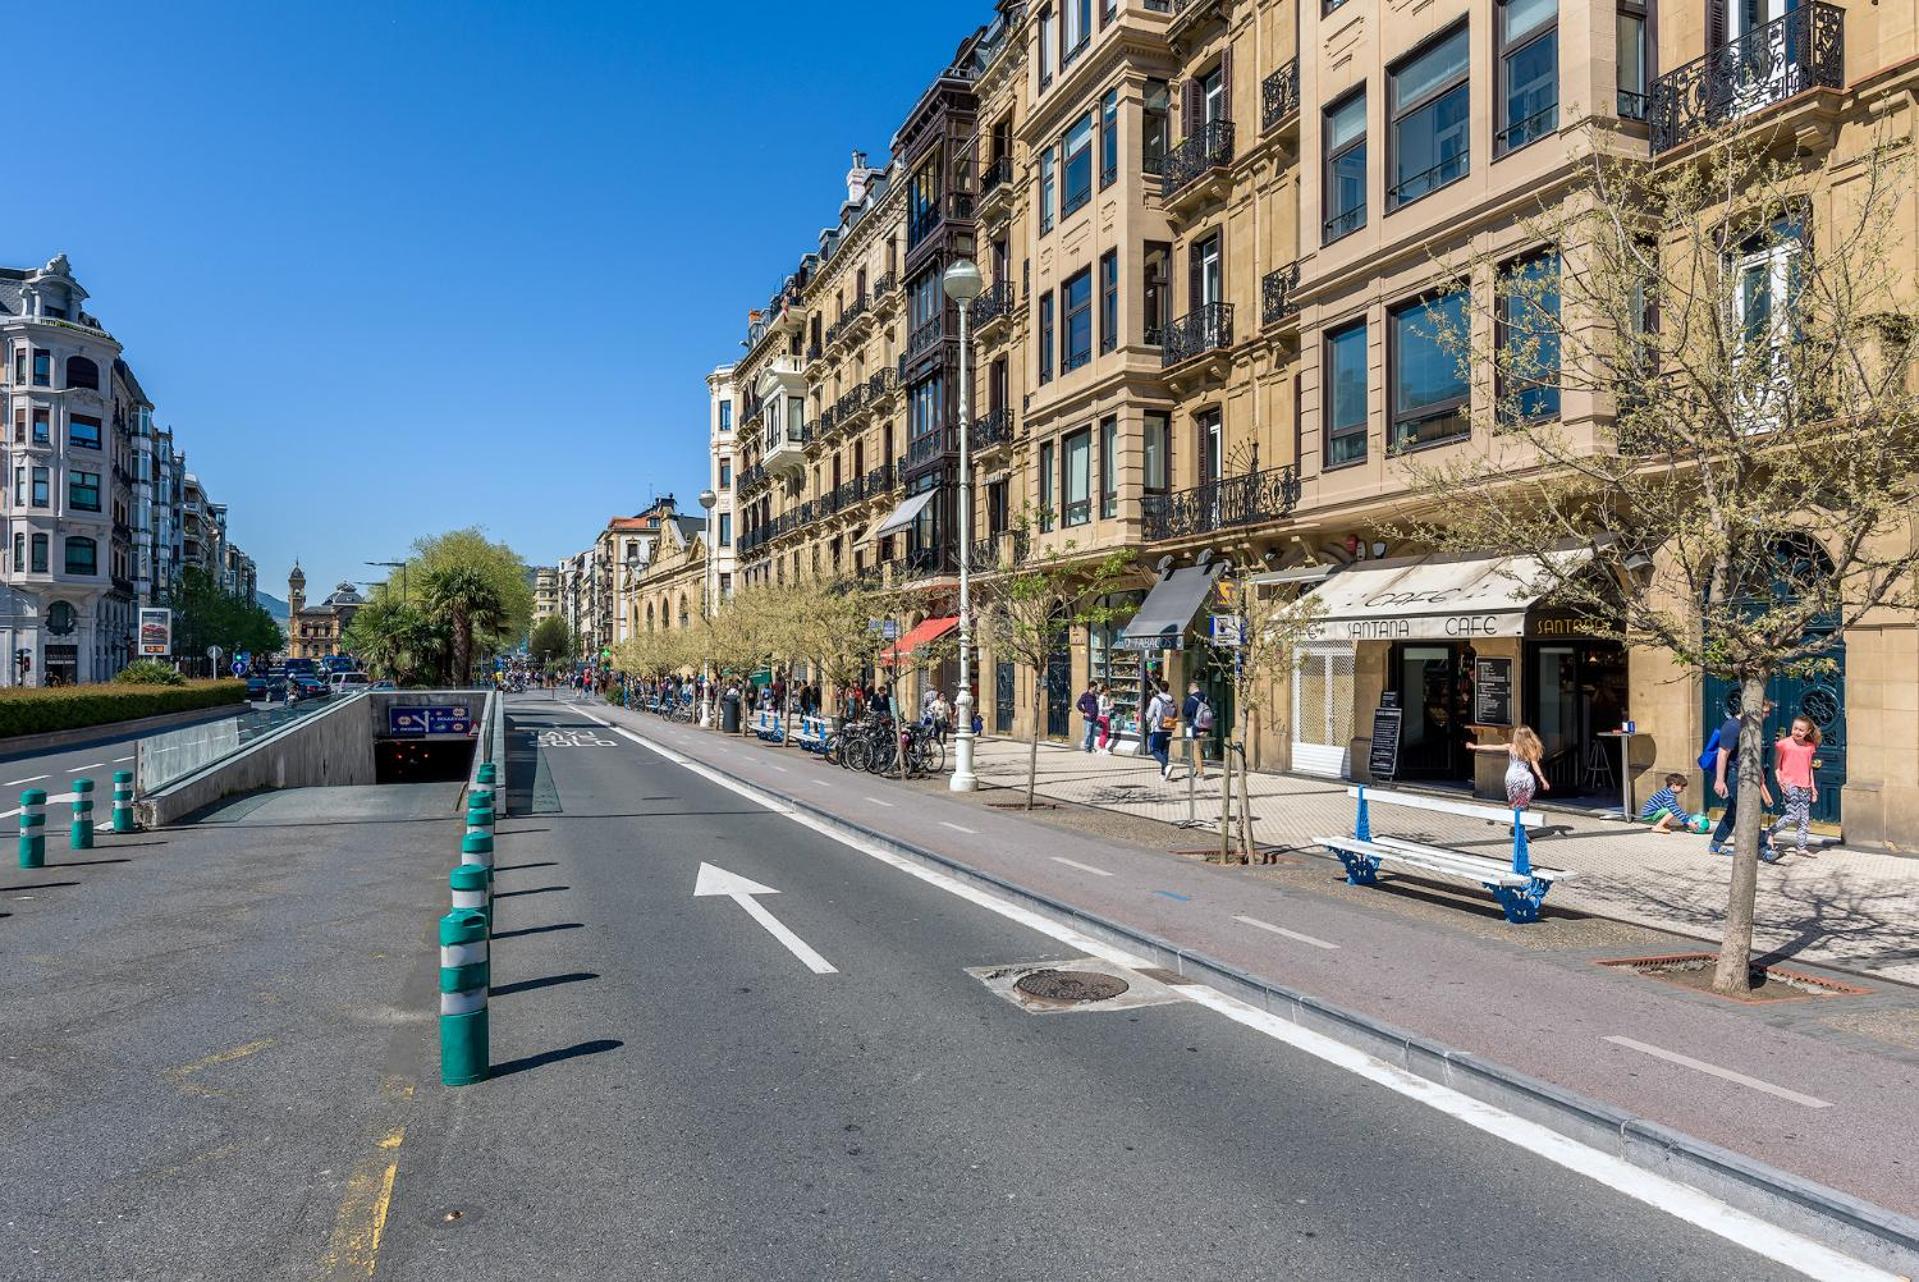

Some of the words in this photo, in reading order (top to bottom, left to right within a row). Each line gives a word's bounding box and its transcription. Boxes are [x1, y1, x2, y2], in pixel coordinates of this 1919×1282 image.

[1347, 619, 1410, 639] SANTANA
[1445, 616, 1497, 636] CAFE
[1134, 637, 1172, 649] TABACOS
